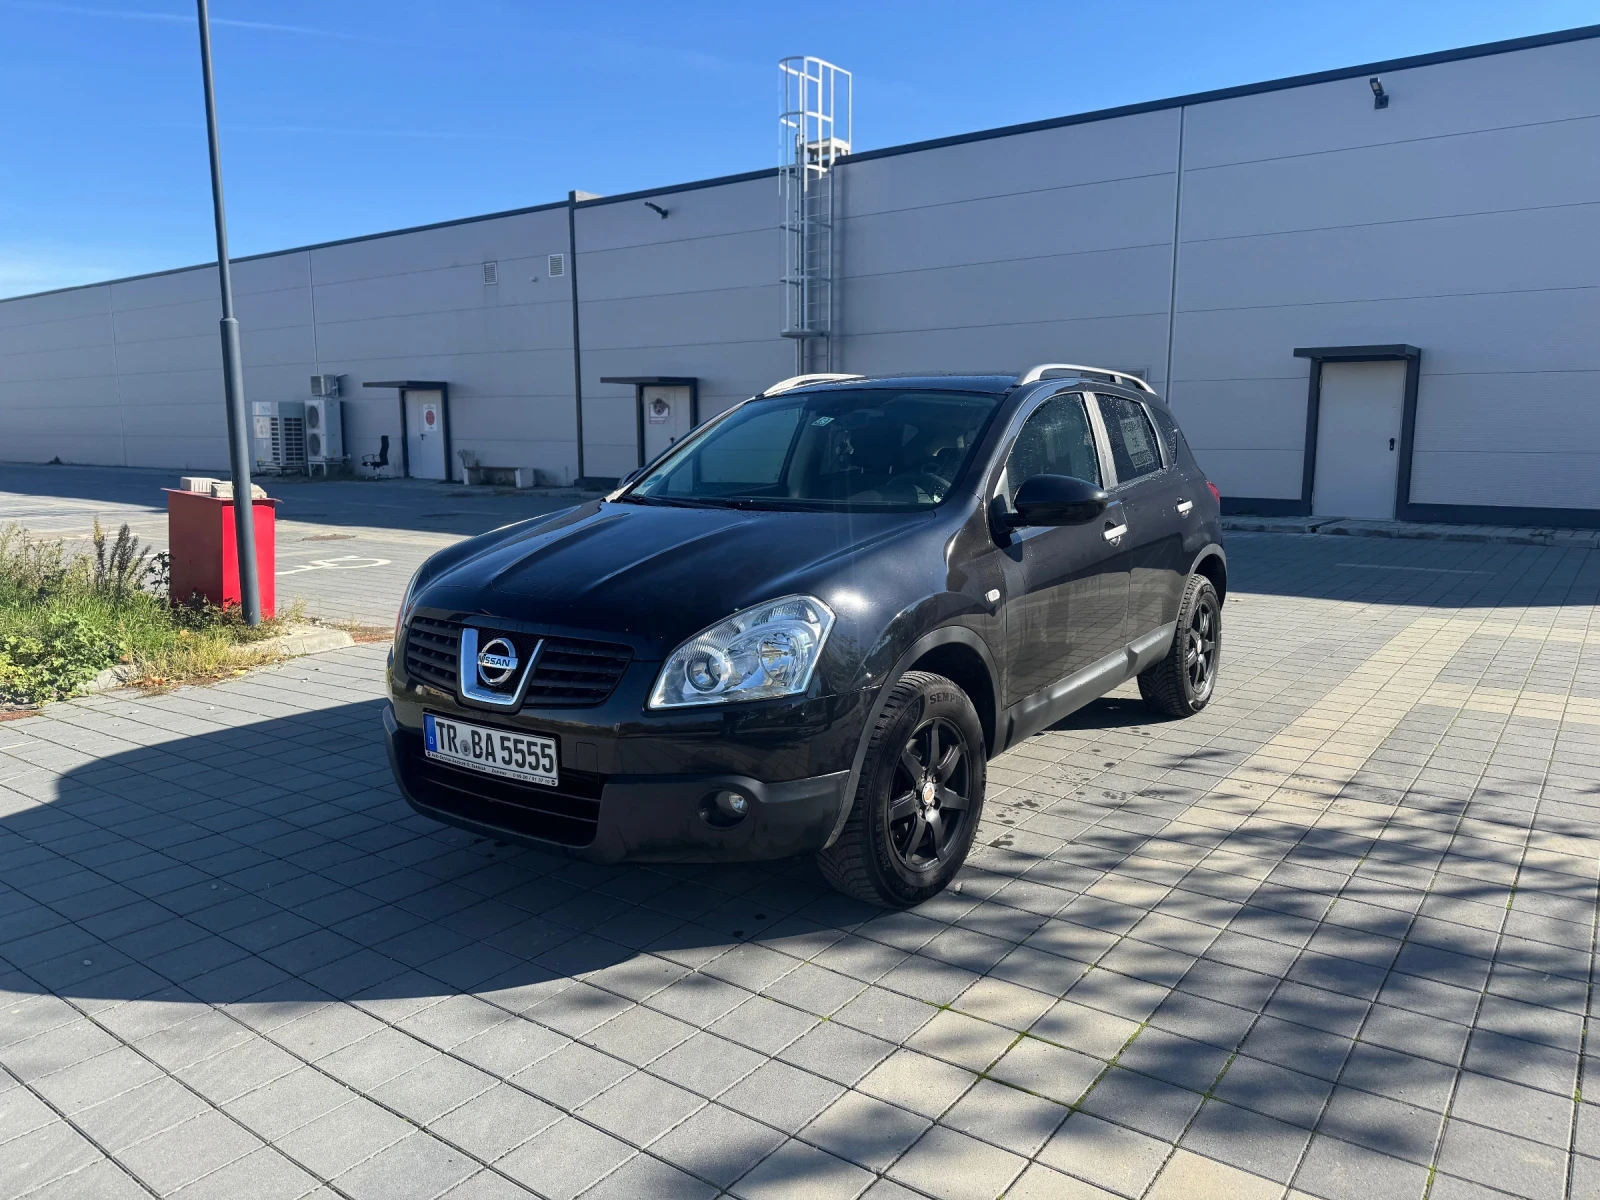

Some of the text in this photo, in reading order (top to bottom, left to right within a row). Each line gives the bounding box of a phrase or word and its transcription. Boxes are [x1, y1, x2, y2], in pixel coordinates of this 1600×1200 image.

[478, 654, 511, 667] NISSAN
[436, 721, 554, 774] TR BA 5555
